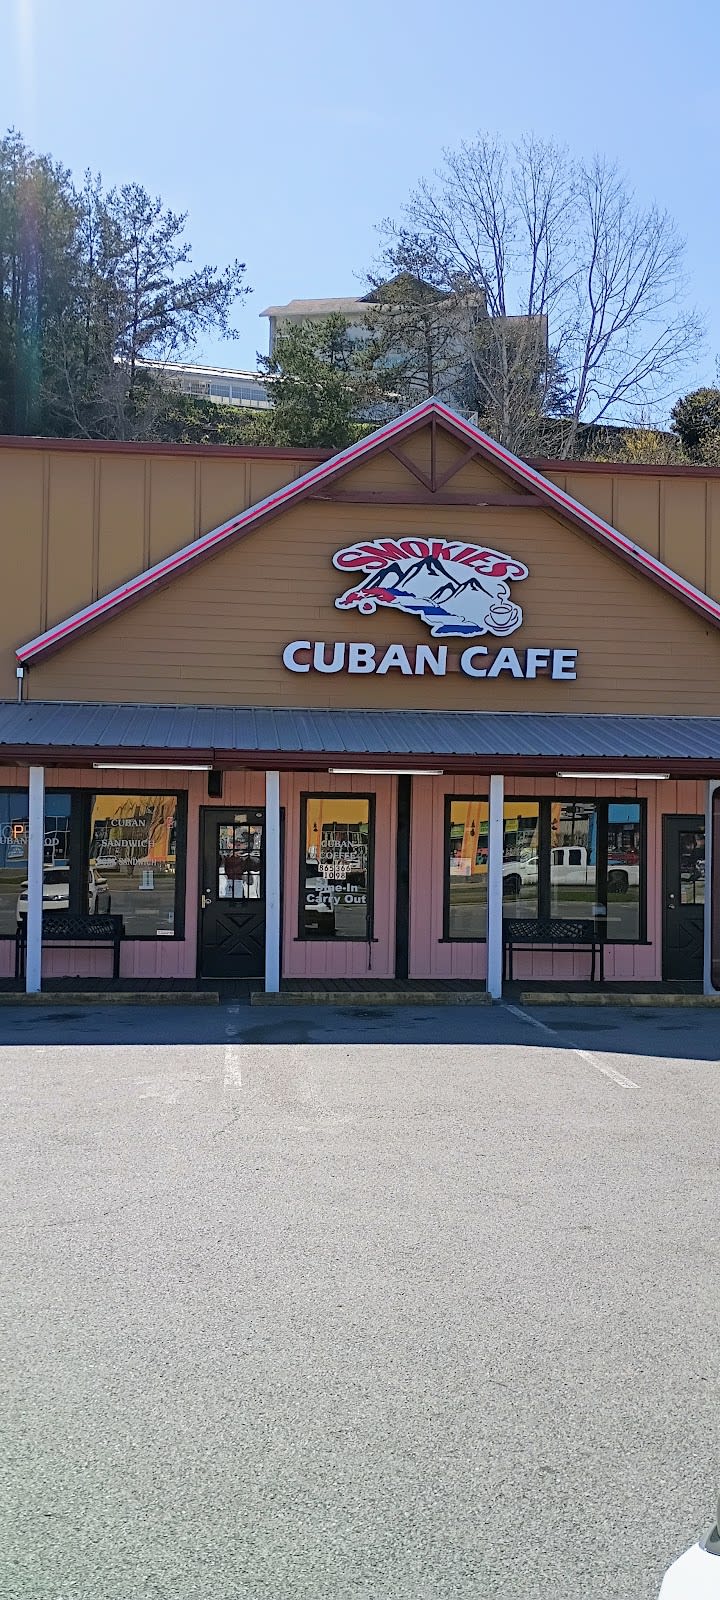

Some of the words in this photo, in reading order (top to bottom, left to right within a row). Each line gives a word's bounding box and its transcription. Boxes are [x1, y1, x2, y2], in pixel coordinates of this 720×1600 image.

[336, 540, 526, 578] SMOKIES
[282, 640, 449, 676] CUBAN
[459, 645, 579, 680] CAFE
[110, 819, 146, 827] CUBAN
[0, 837, 28, 845] UBAN
[101, 839, 155, 848] SANDWICH
[321, 840, 354, 848] CUBAN
[320, 851, 356, 860] COFFEE
[306, 894, 340, 905] Carry
[344, 894, 367, 904] Out
